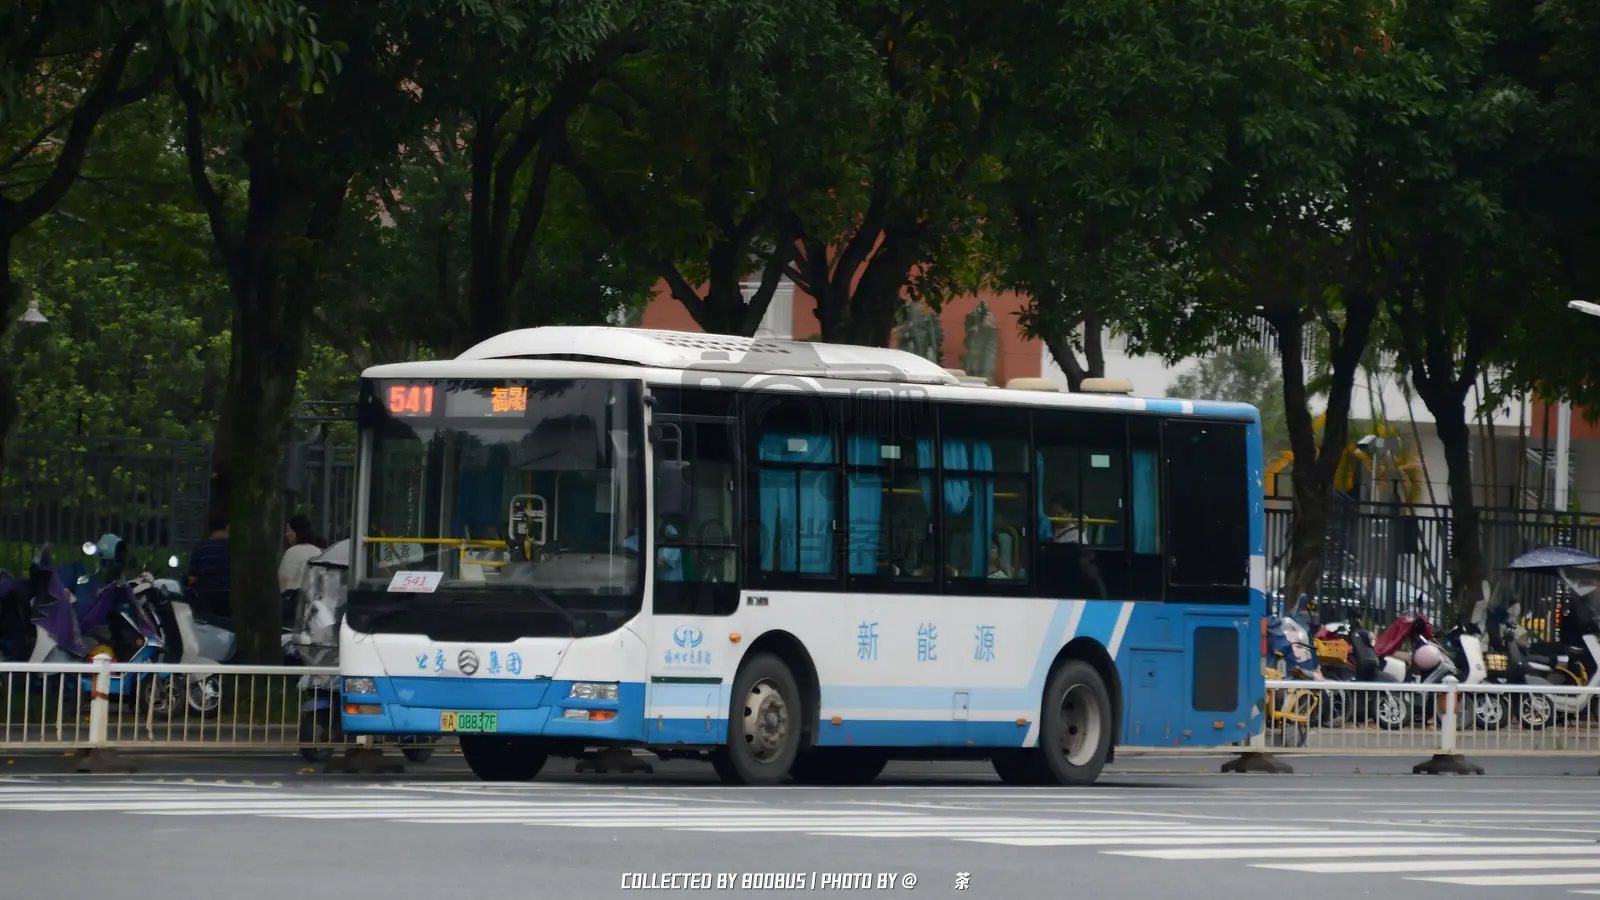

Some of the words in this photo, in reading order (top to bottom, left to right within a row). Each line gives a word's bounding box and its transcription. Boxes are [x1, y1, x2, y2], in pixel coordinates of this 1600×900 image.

[389, 385, 434, 413] 541
[404, 575, 428, 587] 541
[857, 621, 997, 663] 新能源
